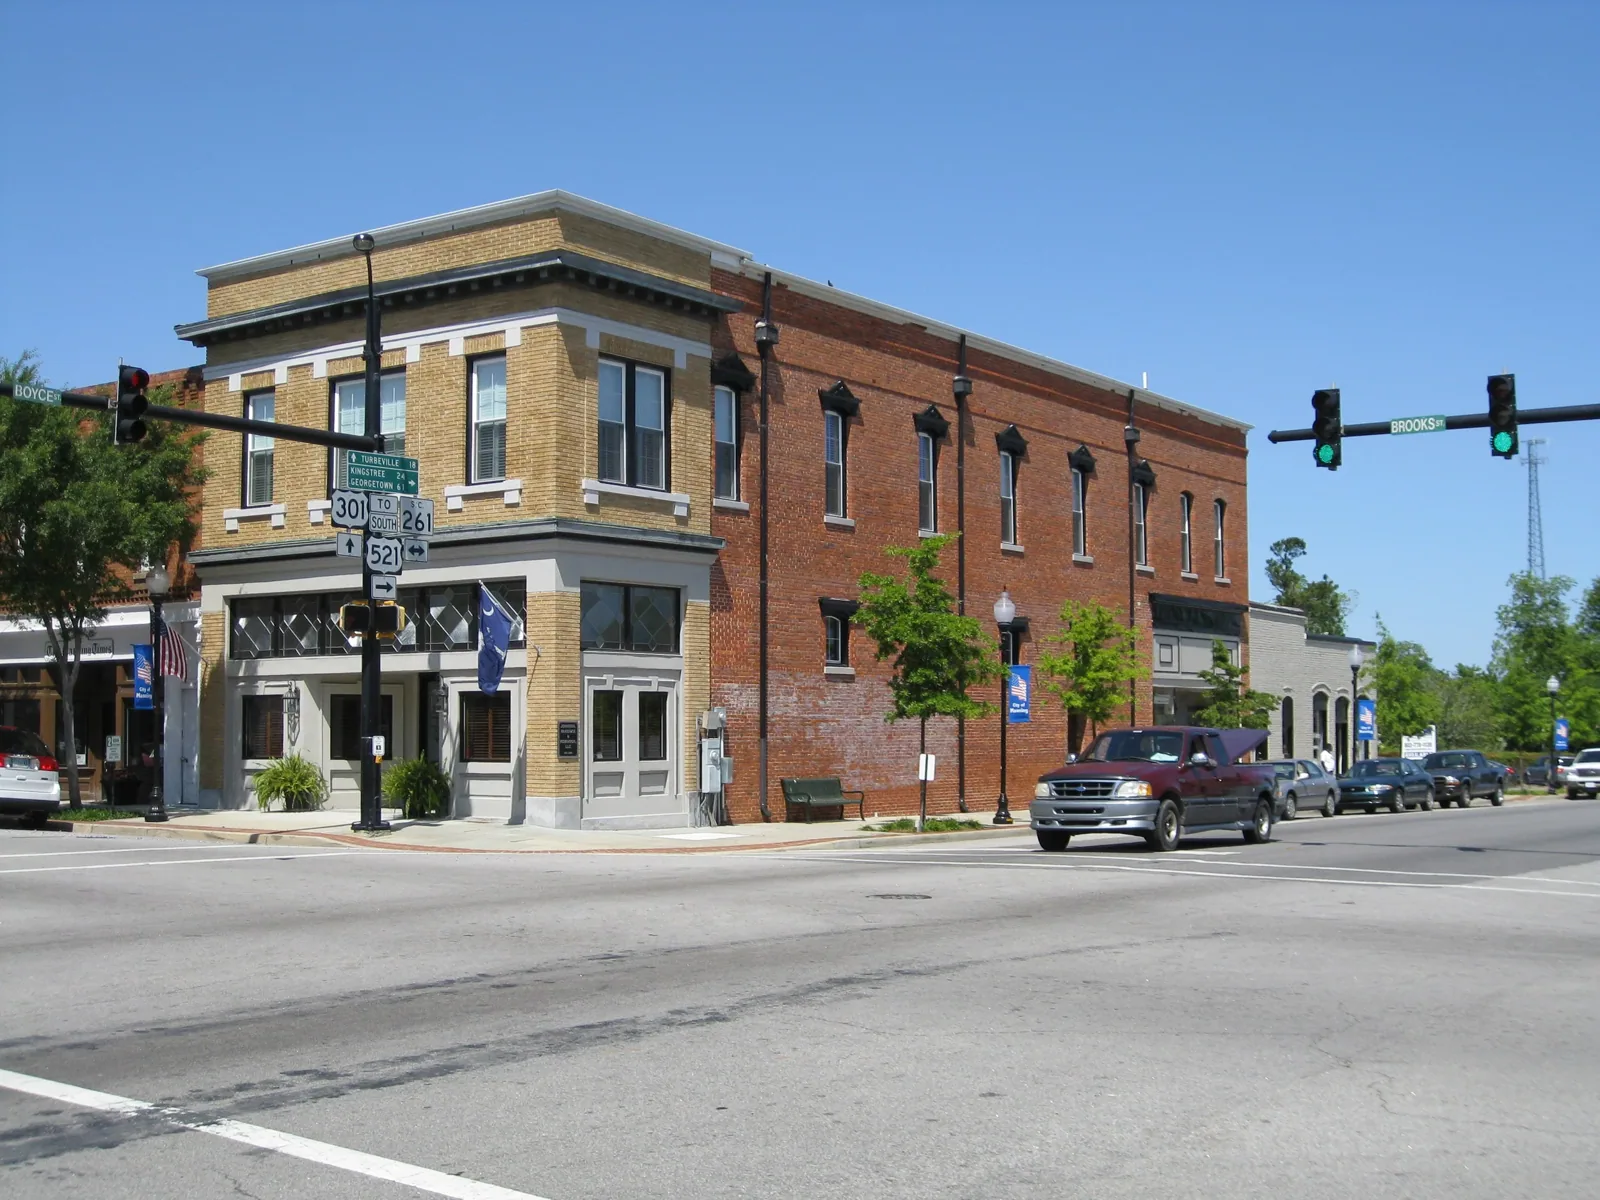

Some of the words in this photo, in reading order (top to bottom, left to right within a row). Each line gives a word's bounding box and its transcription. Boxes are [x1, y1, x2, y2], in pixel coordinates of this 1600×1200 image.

[15, 384, 54, 403] BOYCE
[1391, 418, 1435, 433] BROOKS
[361, 455, 399, 467] TURBEVILLE
[409, 461, 416, 469] 18
[350, 467, 385, 478] KINGSTREE
[397, 472, 405, 480] 24
[350, 478, 393, 489] GEORGETOWN
[397, 483, 405, 491] 61
[335, 496, 365, 520] 301
[377, 498, 391, 510] TO
[371, 516, 397, 530] SOUTH
[403, 510, 431, 532] 261
[370, 543, 398, 566] 521
